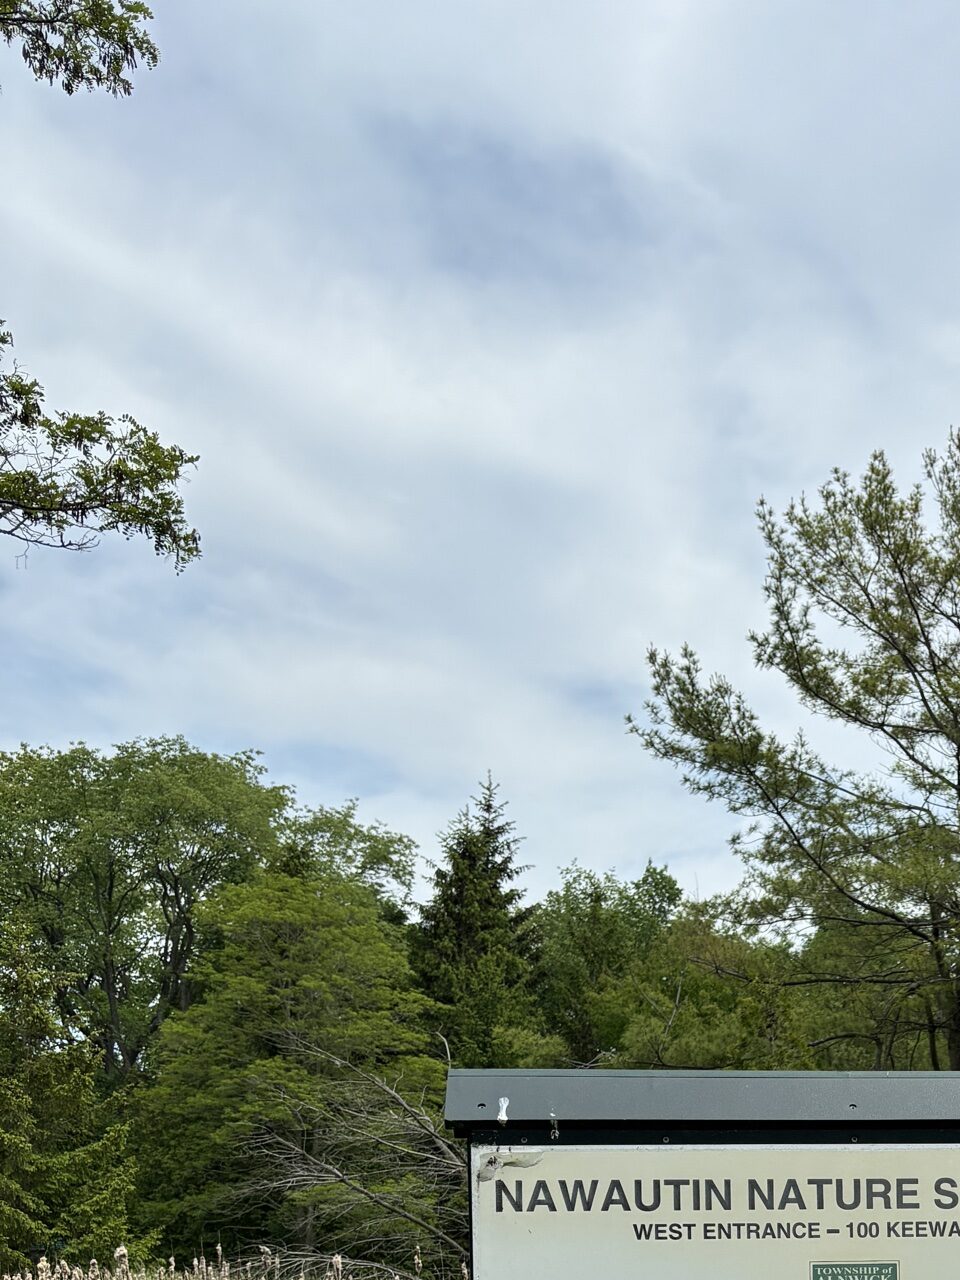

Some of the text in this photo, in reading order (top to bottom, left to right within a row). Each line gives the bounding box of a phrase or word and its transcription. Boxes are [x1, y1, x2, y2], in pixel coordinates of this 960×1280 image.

[495, 1179, 731, 1212] NAWAUTIN
[748, 1178, 920, 1210] NATURE
[633, 1223, 696, 1240] WEST
[703, 1222, 820, 1239] ENTRANCE
[846, 1222, 879, 1238] 100
[815, 1267, 880, 1275] TOWNSHIP
